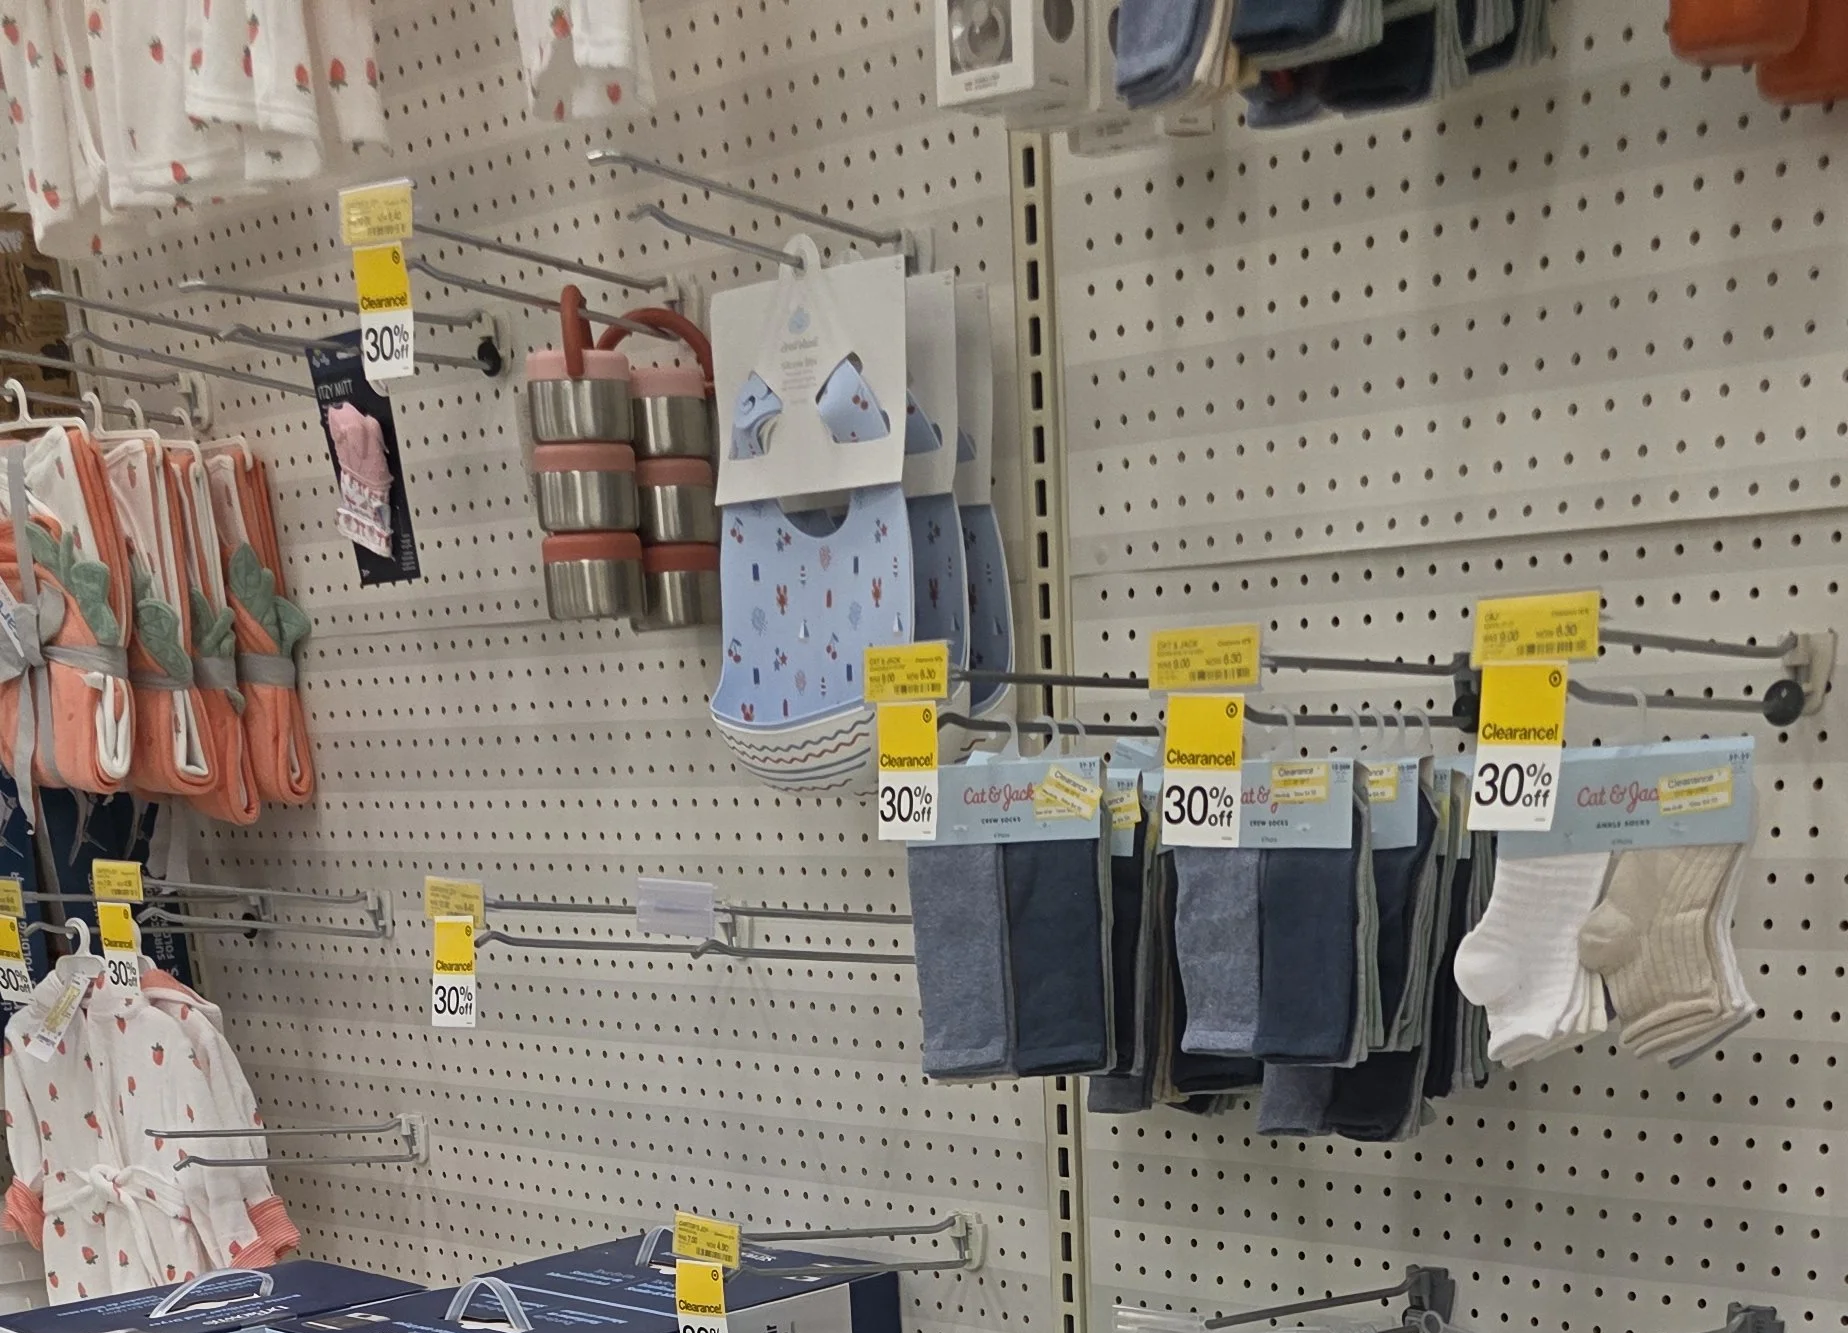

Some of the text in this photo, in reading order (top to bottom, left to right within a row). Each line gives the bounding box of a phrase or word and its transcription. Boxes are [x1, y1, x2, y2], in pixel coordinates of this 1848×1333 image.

[361, 293, 407, 311] Clearance!
[394, 344, 409, 360] off
[1482, 723, 1559, 741] Clearance!
[880, 753, 933, 768] Clearance!
[1167, 749, 1235, 766] Clearance!
[964, 786, 986, 806] Cat
[1003, 782, 1034, 811] Jack
[1241, 786, 1256, 805] at
[1522, 790, 1550, 807] off
[1577, 785, 1606, 807] Cat
[1626, 781, 1660, 813] Jac
[913, 808, 931, 823] off
[1208, 810, 1232, 827] off
[104, 939, 134, 949] Clearance!
[436, 960, 472, 971] Clearance!
[20, 982, 31, 994] off
[129, 977, 138, 988] off
[459, 1003, 472, 1015] off
[678, 1300, 722, 1314] Clearance!
